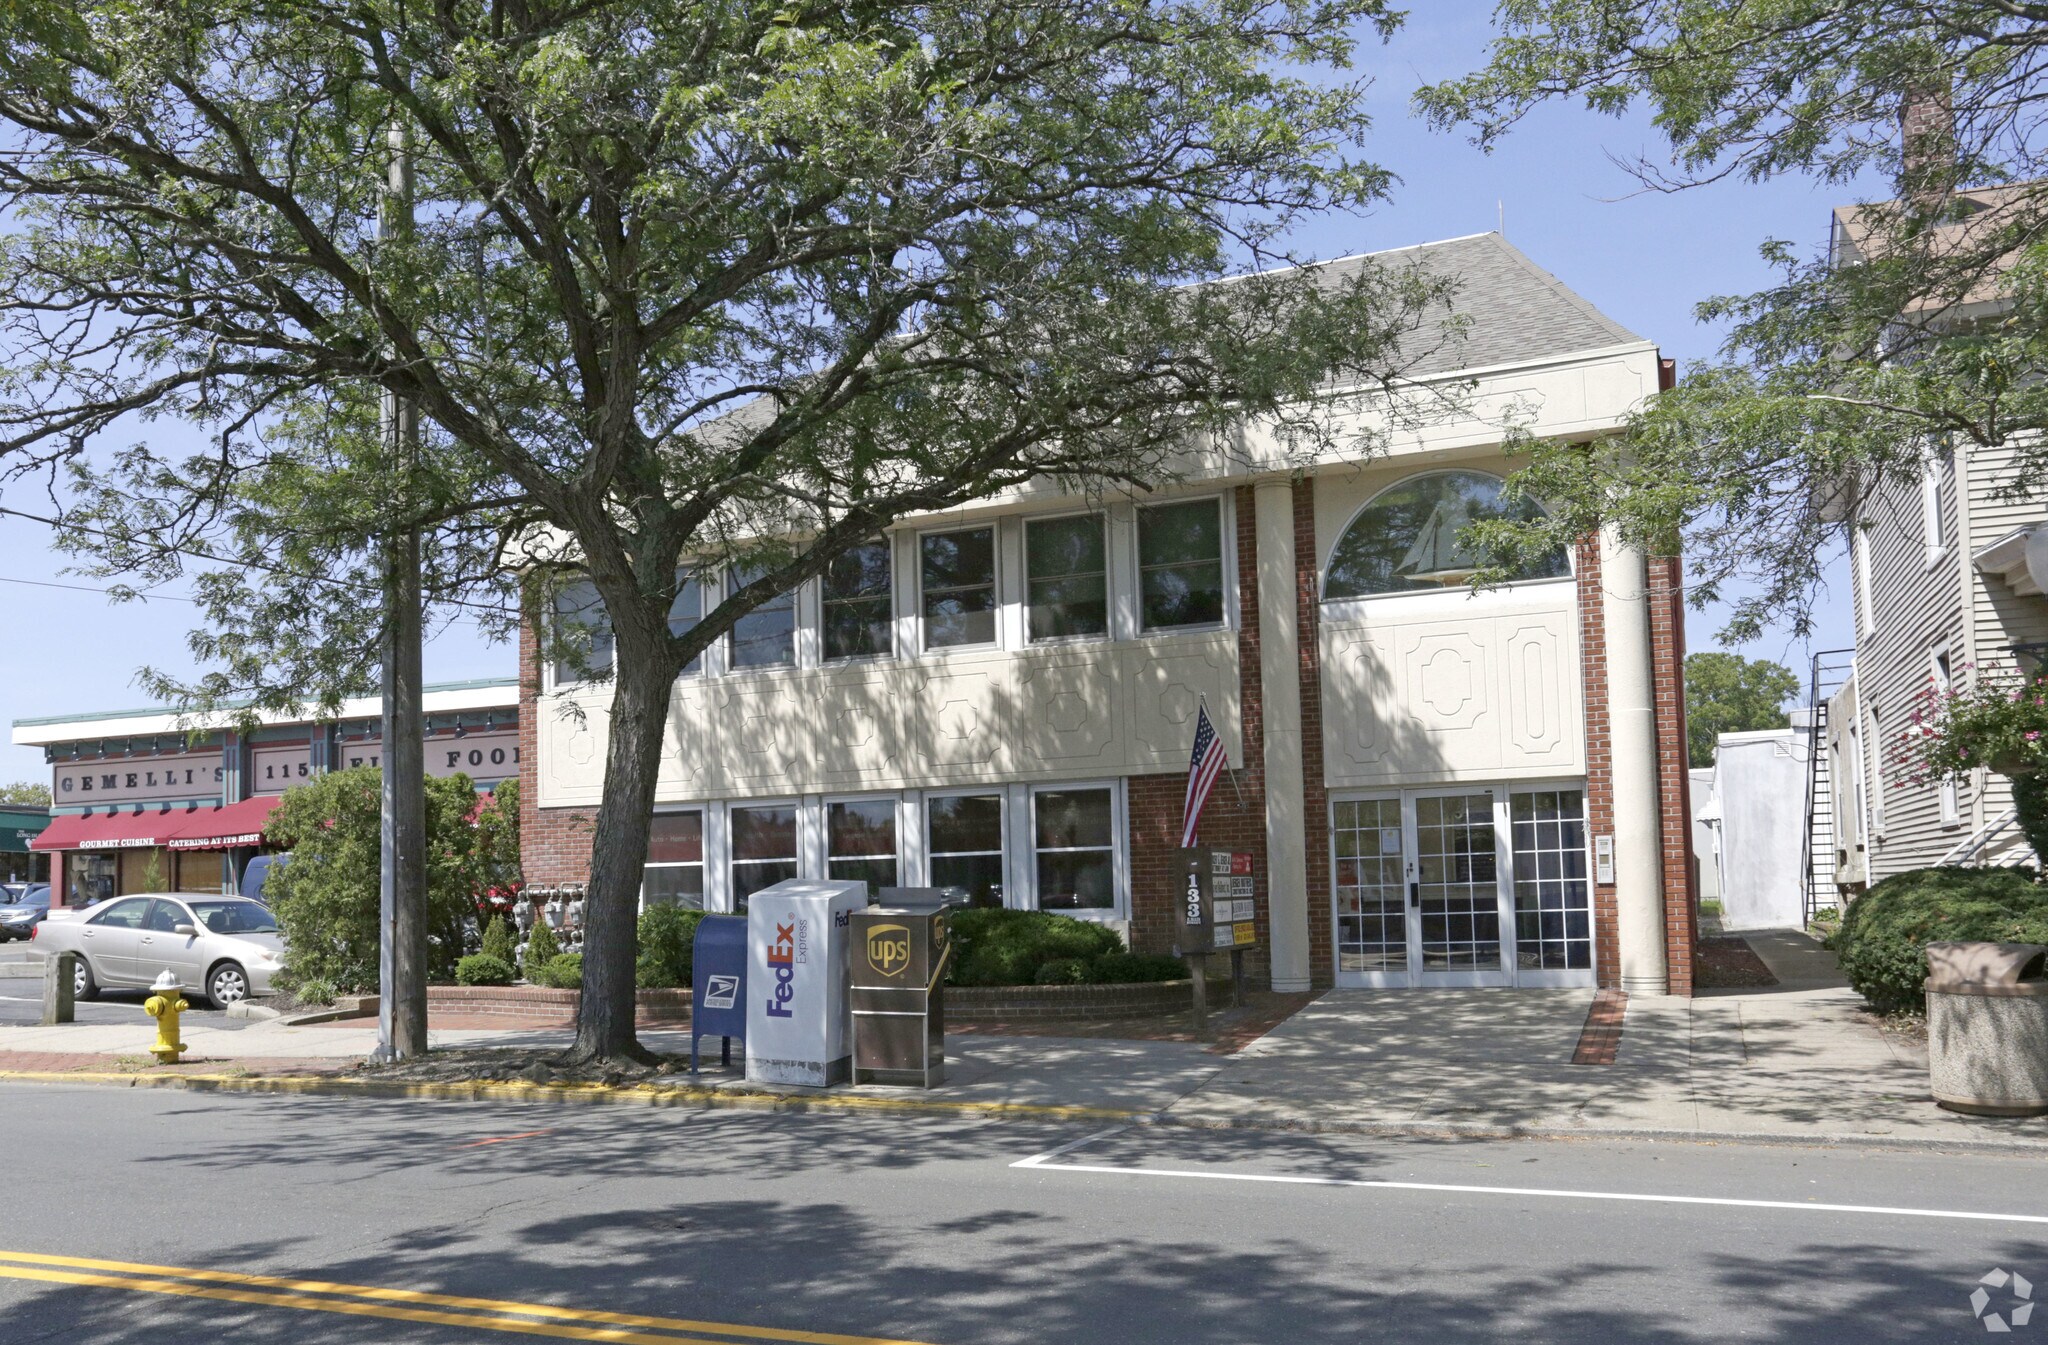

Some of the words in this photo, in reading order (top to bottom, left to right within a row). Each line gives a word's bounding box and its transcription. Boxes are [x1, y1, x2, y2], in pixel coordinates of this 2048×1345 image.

[61, 766, 223, 793] GEMELLI'S
[265, 762, 309, 779] 115
[79, 839, 120, 849] GOURMET
[120, 837, 155, 847] CUISINE
[168, 837, 210, 848] CATERING
[210, 837, 222, 846] AT
[222, 836, 237, 844] ITS
[237, 834, 260, 843] BEST
[1187, 873, 1200, 918] 133
[795, 919, 808, 964] Express
[870, 940, 907, 969] ups
[766, 922, 794, 1019] FedEx
